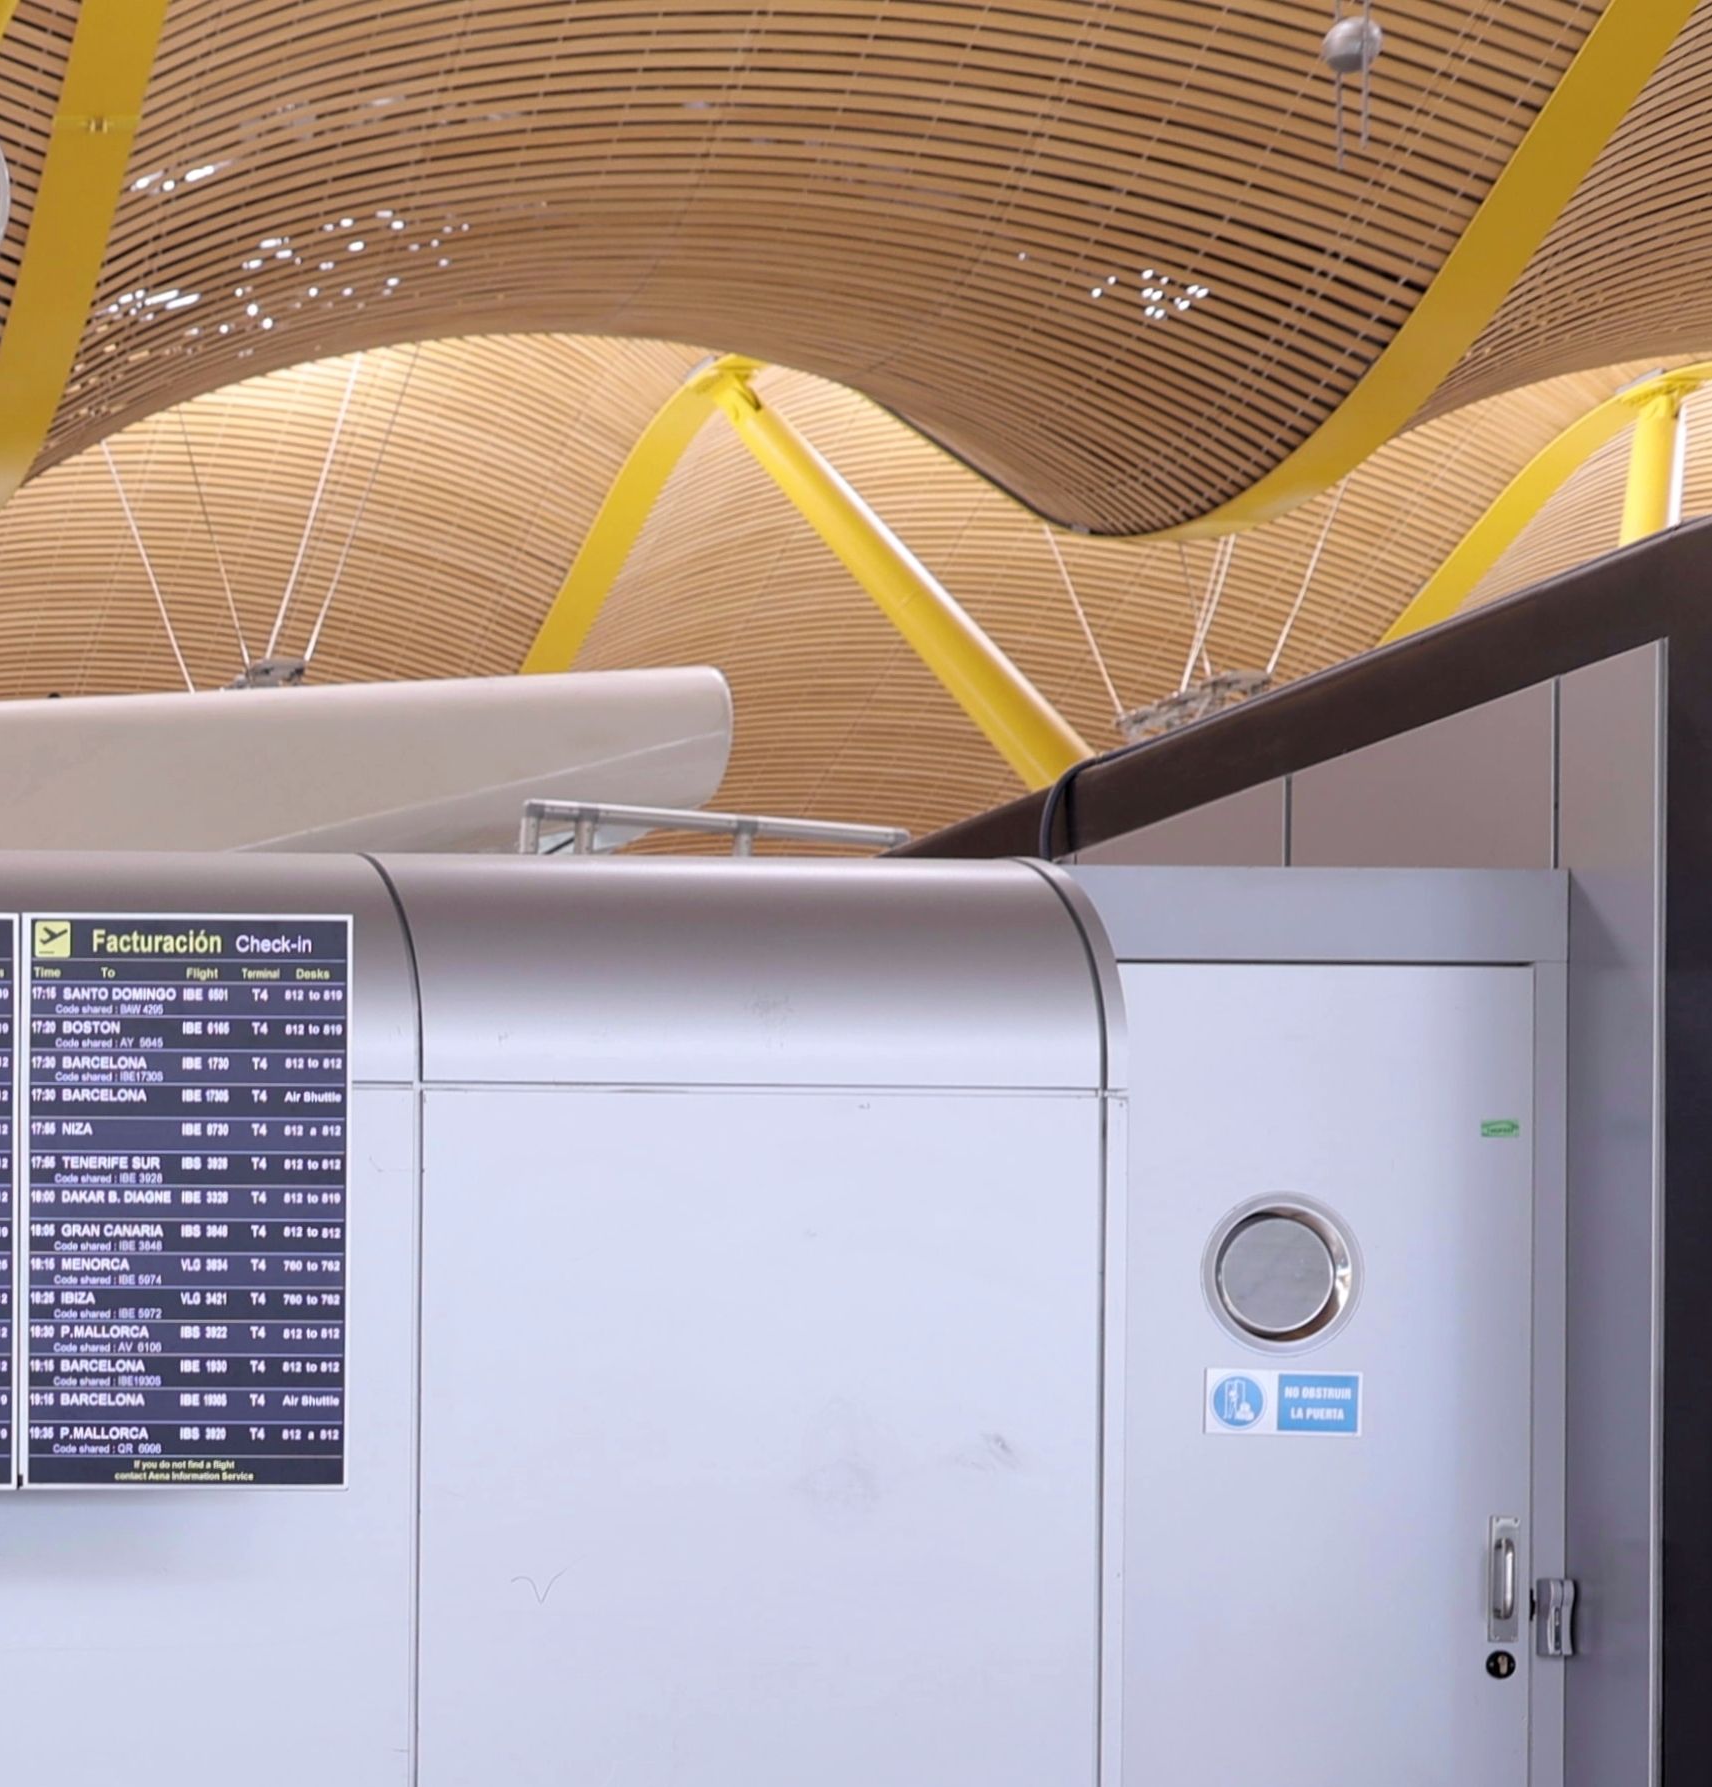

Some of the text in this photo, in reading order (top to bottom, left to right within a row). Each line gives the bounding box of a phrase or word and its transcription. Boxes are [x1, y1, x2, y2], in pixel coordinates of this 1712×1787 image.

[92, 929, 312, 953] Facturación Check-in
[34, 967, 330, 980] Time To Flight Terminal Desks
[62, 987, 176, 1001] SANTO DOMINGO
[62, 1021, 120, 1034] BOSTON
[62, 1056, 147, 1070] BARCELONA
[62, 1089, 147, 1102] BARCELONA
[62, 1123, 93, 1136] NIZA
[62, 1156, 160, 1170] TENERIFE SUR
[62, 1190, 171, 1204] DAKAR DIAGNE
[61, 1224, 163, 1238] GRAN CANARIA
[61, 1258, 130, 1271] MENORCA
[61, 1292, 95, 1305] IBIZA
[60, 1325, 149, 1339] P.MALLORCA
[60, 1359, 145, 1373] BARCELONA
[1285, 1386, 1299, 1399] NO
[60, 1393, 145, 1406] BARCELONA
[1291, 1407, 1344, 1421] LA PUERTA
[60, 1427, 148, 1440] P.MALLORCA
